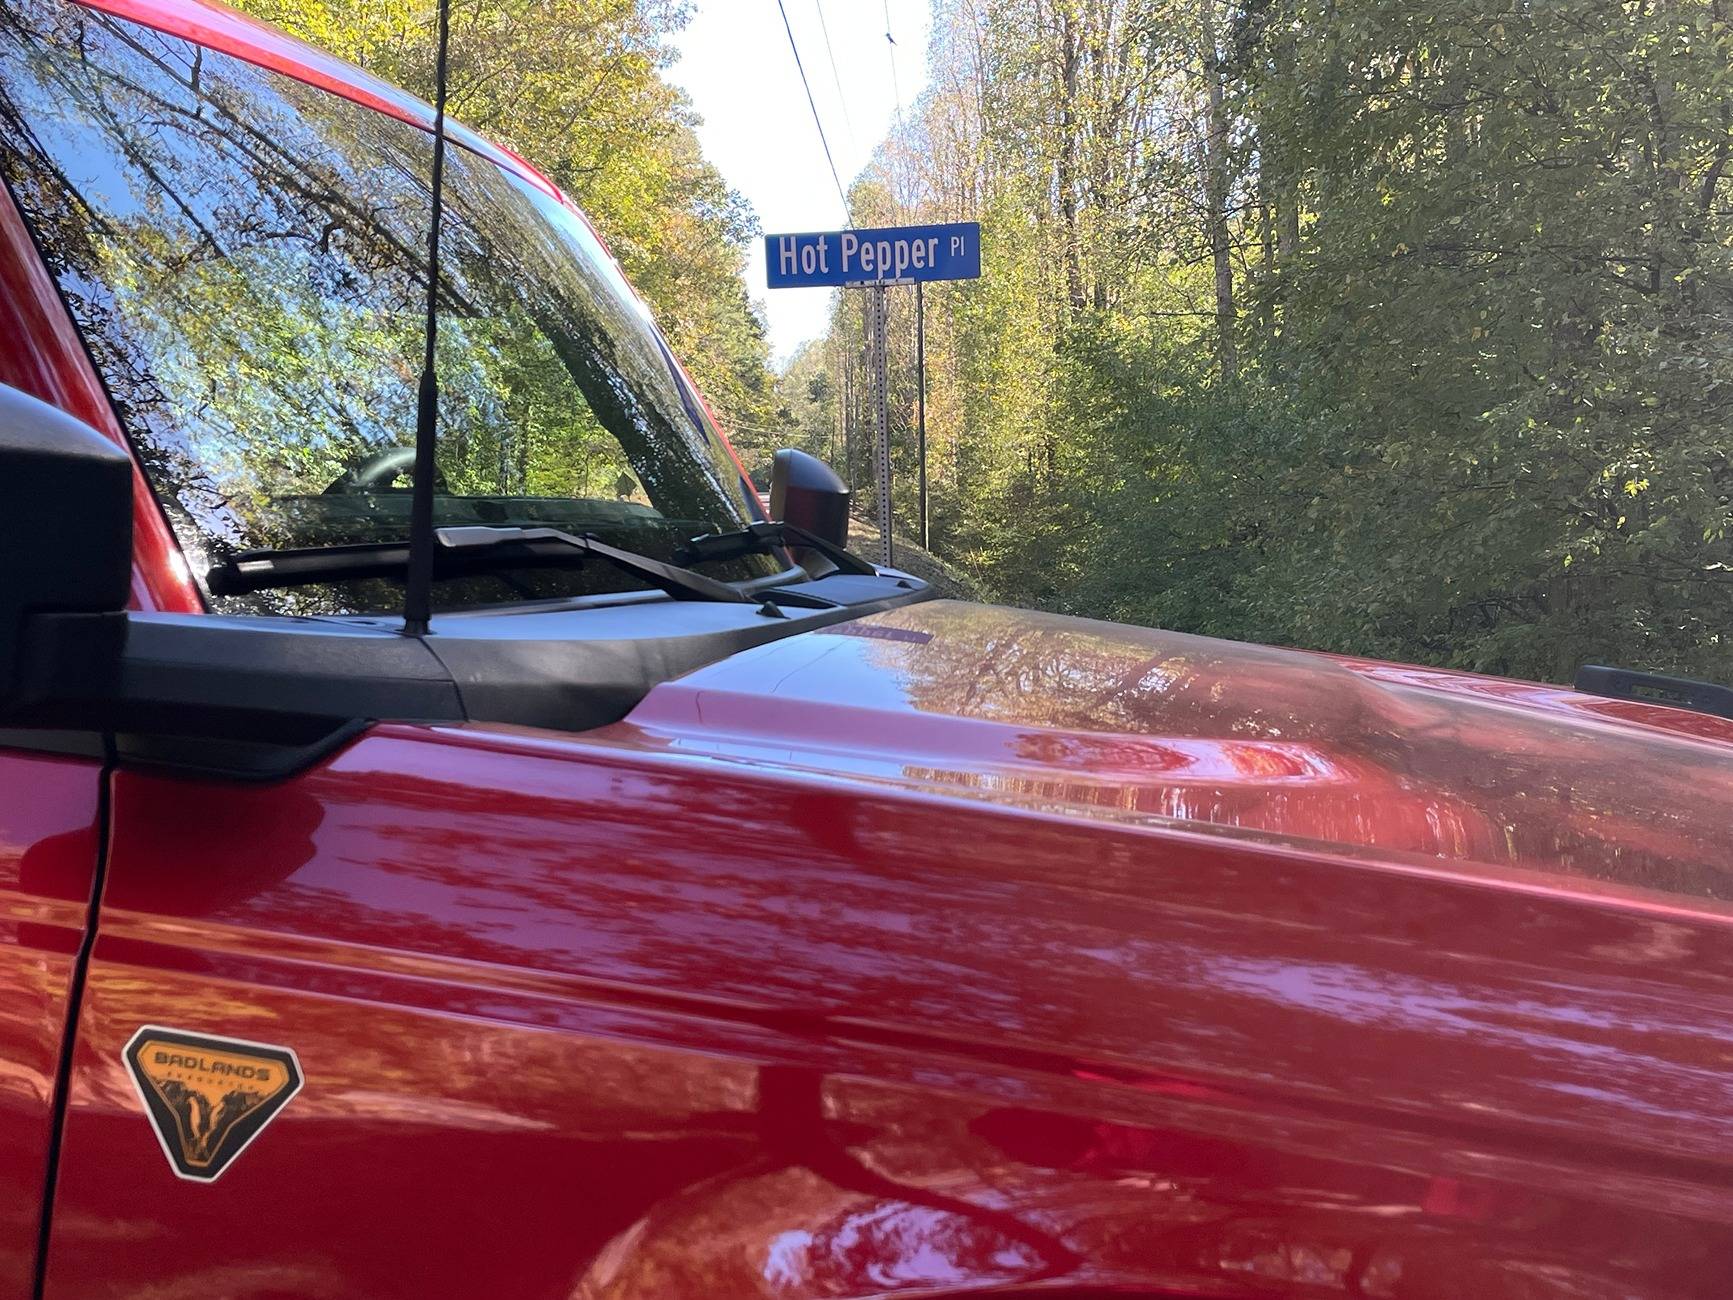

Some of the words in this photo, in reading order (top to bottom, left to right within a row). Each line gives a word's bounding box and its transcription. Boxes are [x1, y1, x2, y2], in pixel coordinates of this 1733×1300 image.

[779, 235, 829, 274] Hot
[841, 233, 938, 279] Pepper
[951, 236, 965, 256] Pl
[154, 1051, 270, 1081] BADLANDS
